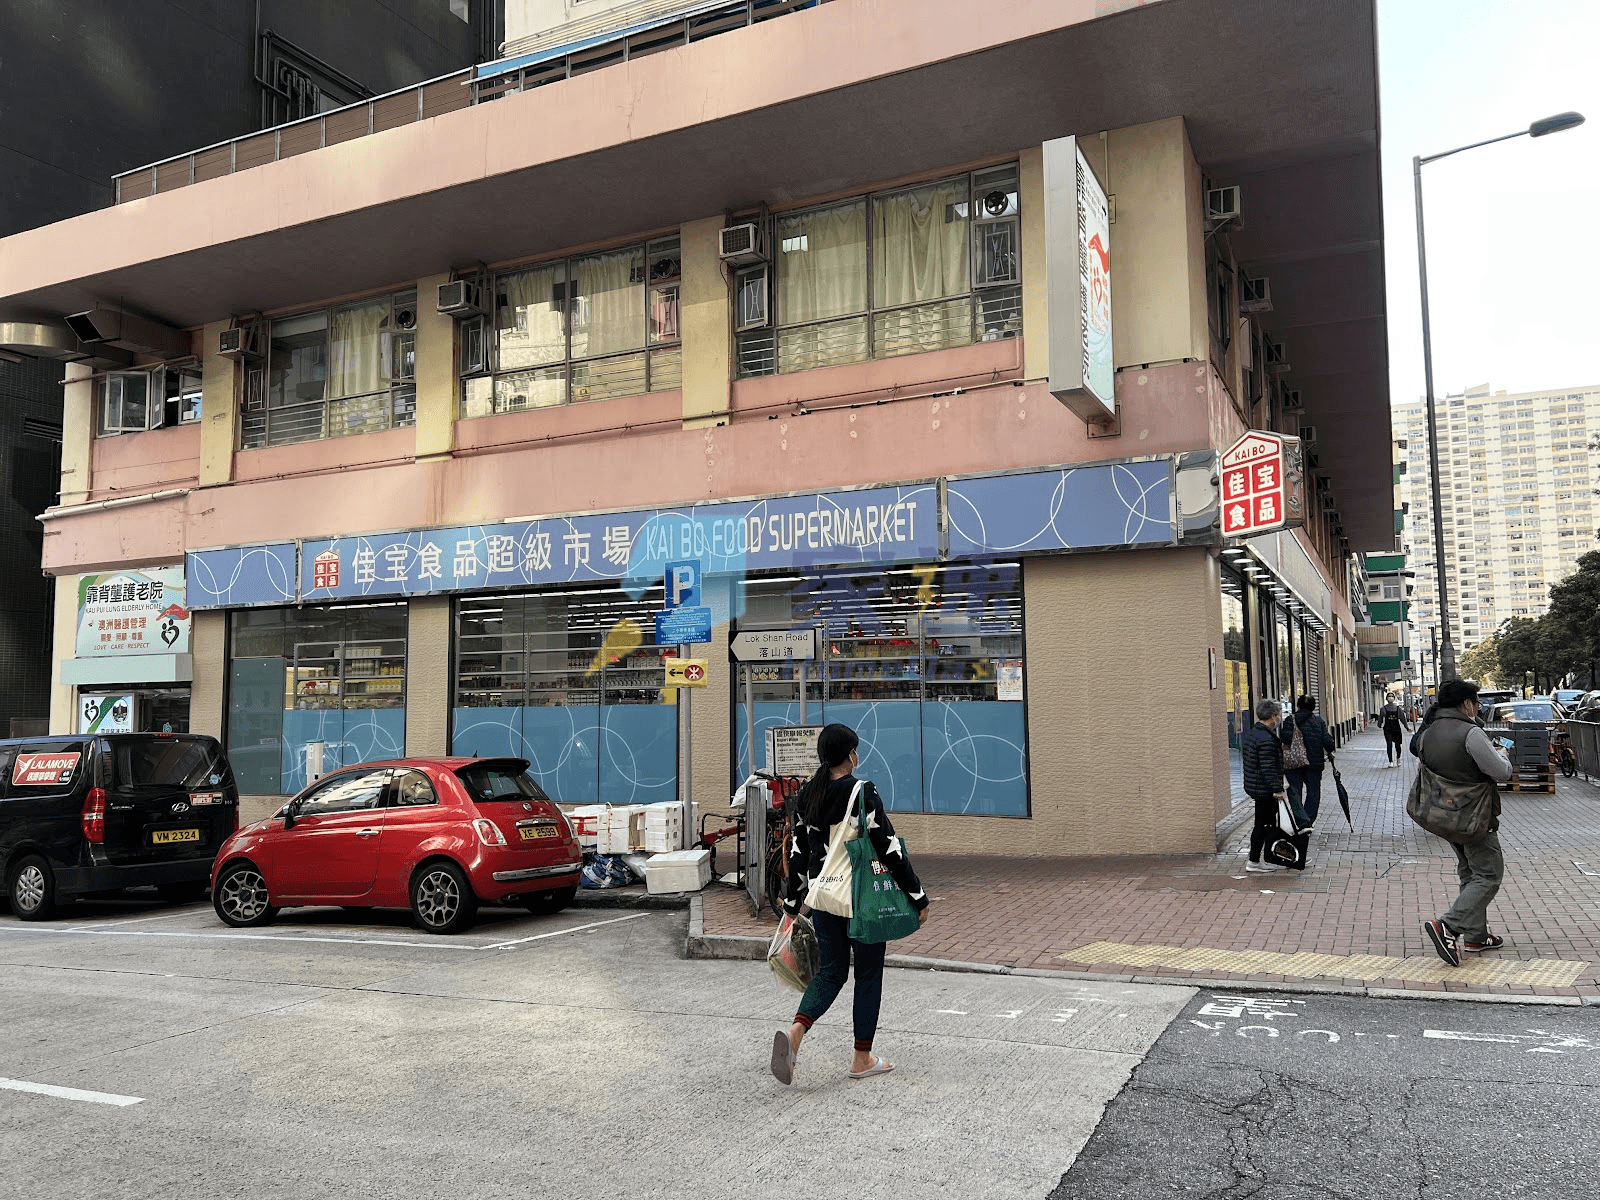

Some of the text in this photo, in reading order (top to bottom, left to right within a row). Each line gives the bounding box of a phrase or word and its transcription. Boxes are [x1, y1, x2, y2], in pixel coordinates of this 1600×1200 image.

[1235, 445, 1265, 461] KAI BO
[1228, 464, 1275, 496] 佳宝
[1229, 497, 1275, 528] 食品
[646, 502, 916, 560] KAI BO FOOD SUPERMARKET
[352, 525, 631, 584] 佳宝食品超級市場
[673, 565, 695, 604] P
[106, 605, 121, 613] LUNG
[122, 604, 145, 612] ELDERLY
[745, 633, 808, 643] Lok Shan Road
[759, 646, 793, 658] 落山道
[30, 759, 76, 769] LALAMOVE
[156, 831, 196, 841] VM 2324
[522, 829, 534, 838] XE
